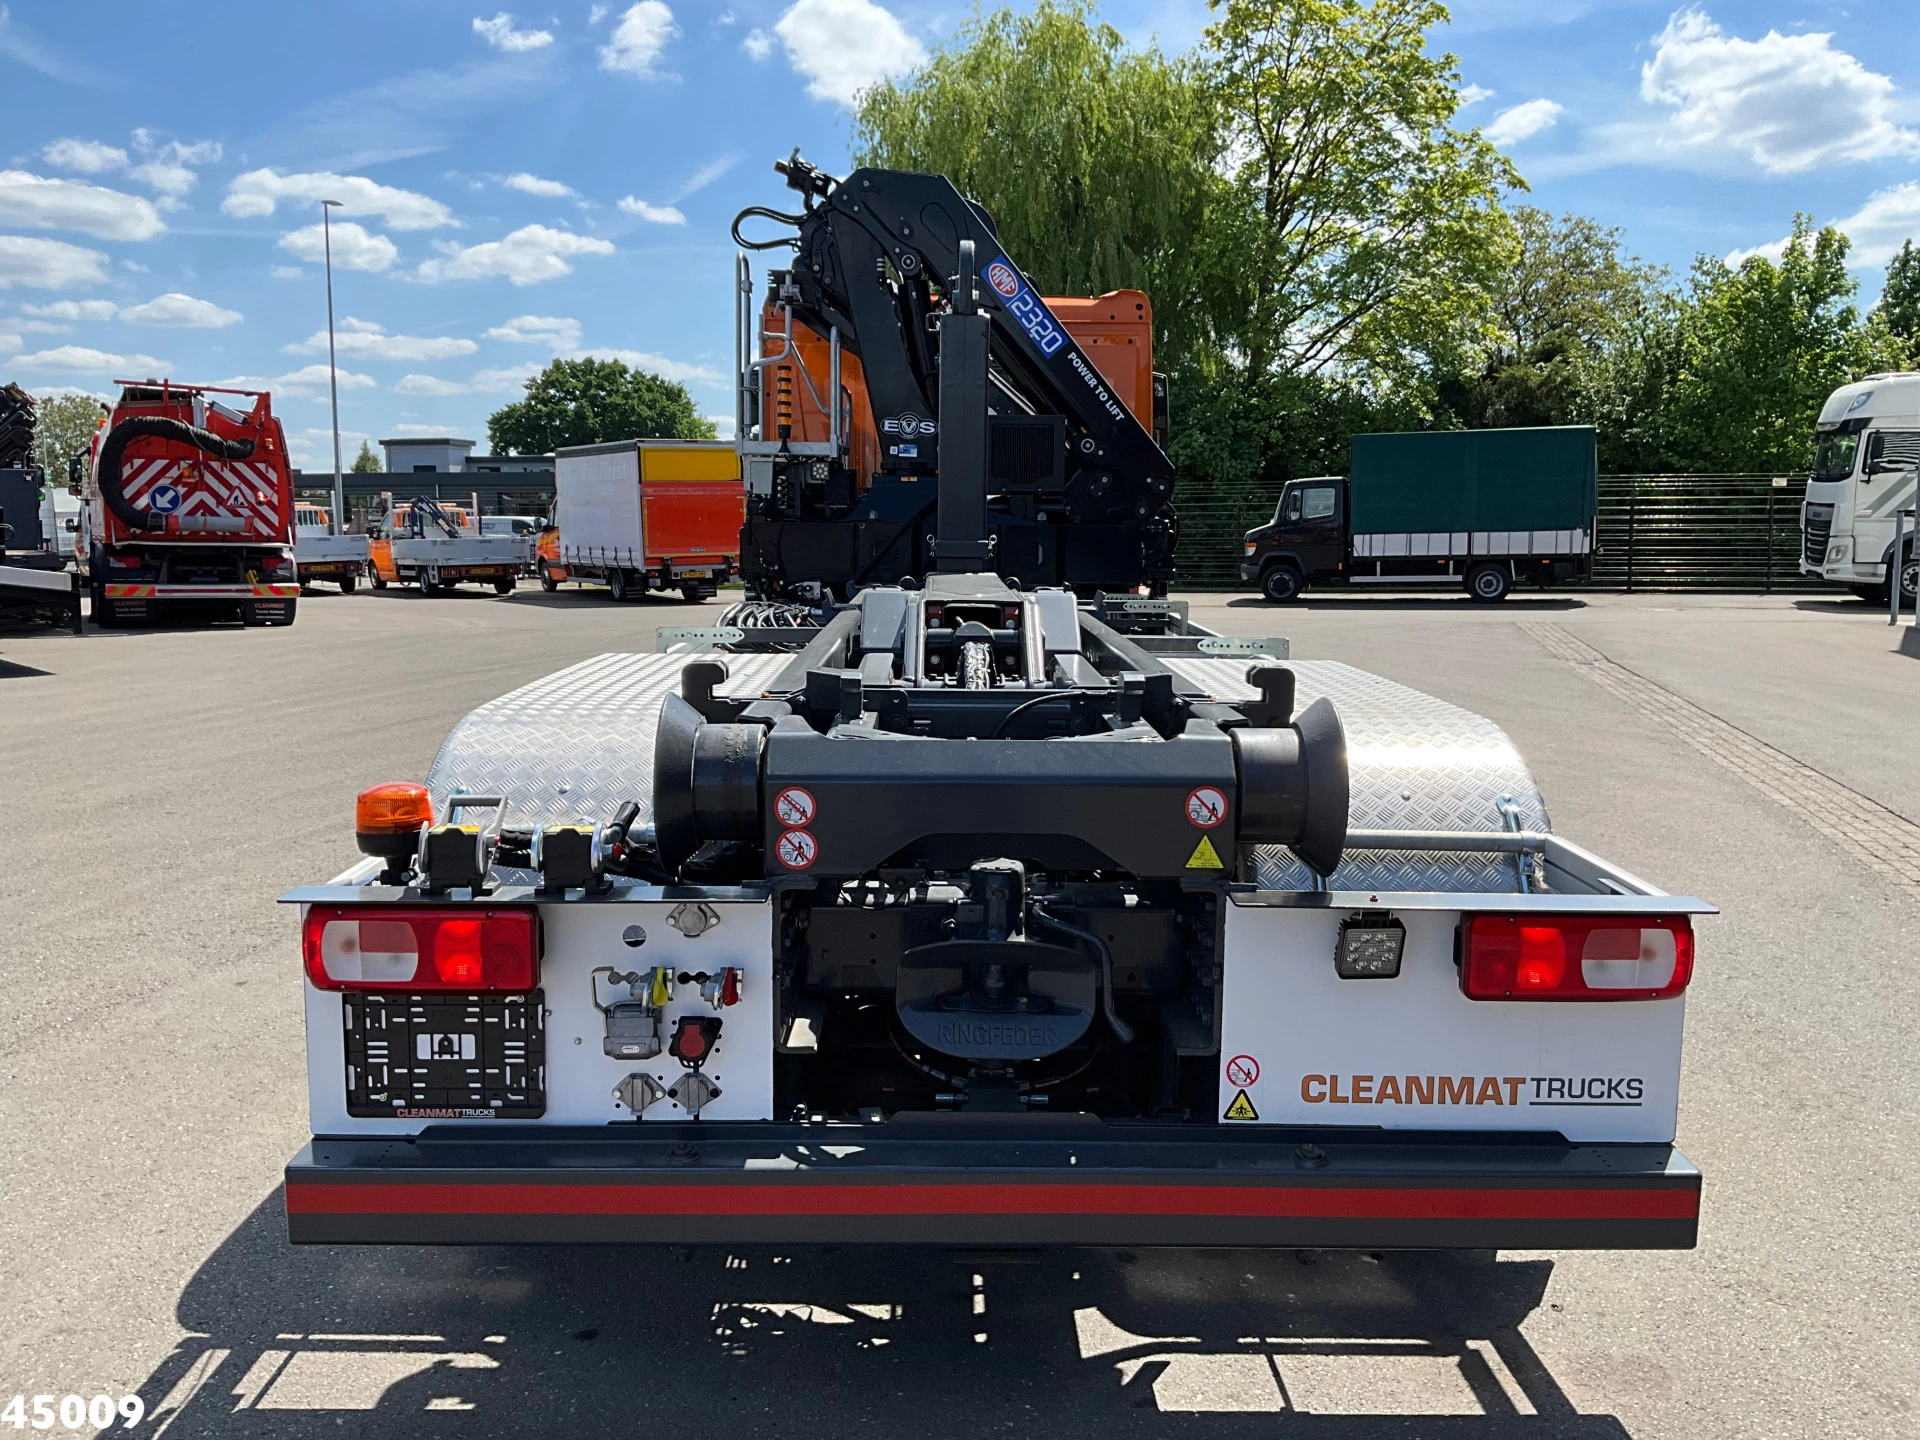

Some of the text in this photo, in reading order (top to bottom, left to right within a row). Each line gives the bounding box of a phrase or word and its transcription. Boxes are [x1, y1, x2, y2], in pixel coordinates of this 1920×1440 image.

[991, 266, 1015, 296] HMF
[1010, 294, 1063, 353] 2320
[1067, 351, 1125, 421] POWER TO LIFT
[937, 1022, 1057, 1047] RINGFEDER
[1300, 1074, 1643, 1106] CLEANMAT TRUCKS
[396, 1108, 496, 1118] CLEANMAT TRUCKS
